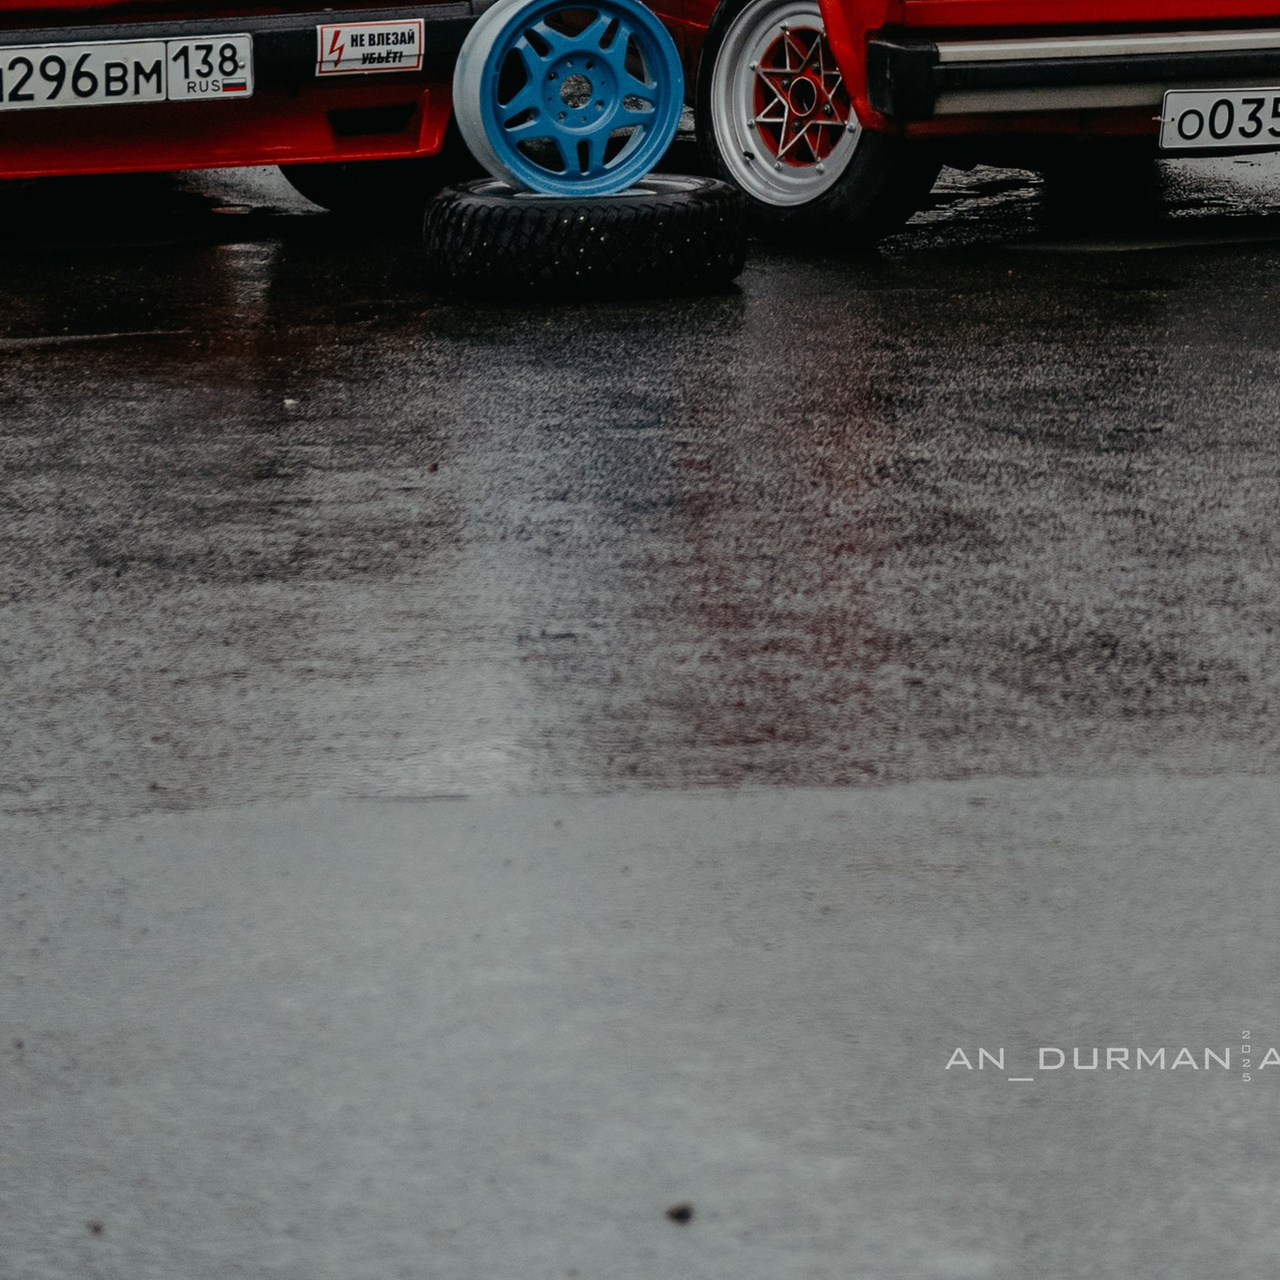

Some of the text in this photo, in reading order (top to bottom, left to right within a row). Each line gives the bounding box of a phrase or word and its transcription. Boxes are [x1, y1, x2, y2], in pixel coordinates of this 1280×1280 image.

[350, 29, 415, 48] НЕ ВЛЕЗАЙ
[0, 43, 239, 103] 296ВМ 138
[187, 80, 221, 94] RUS
